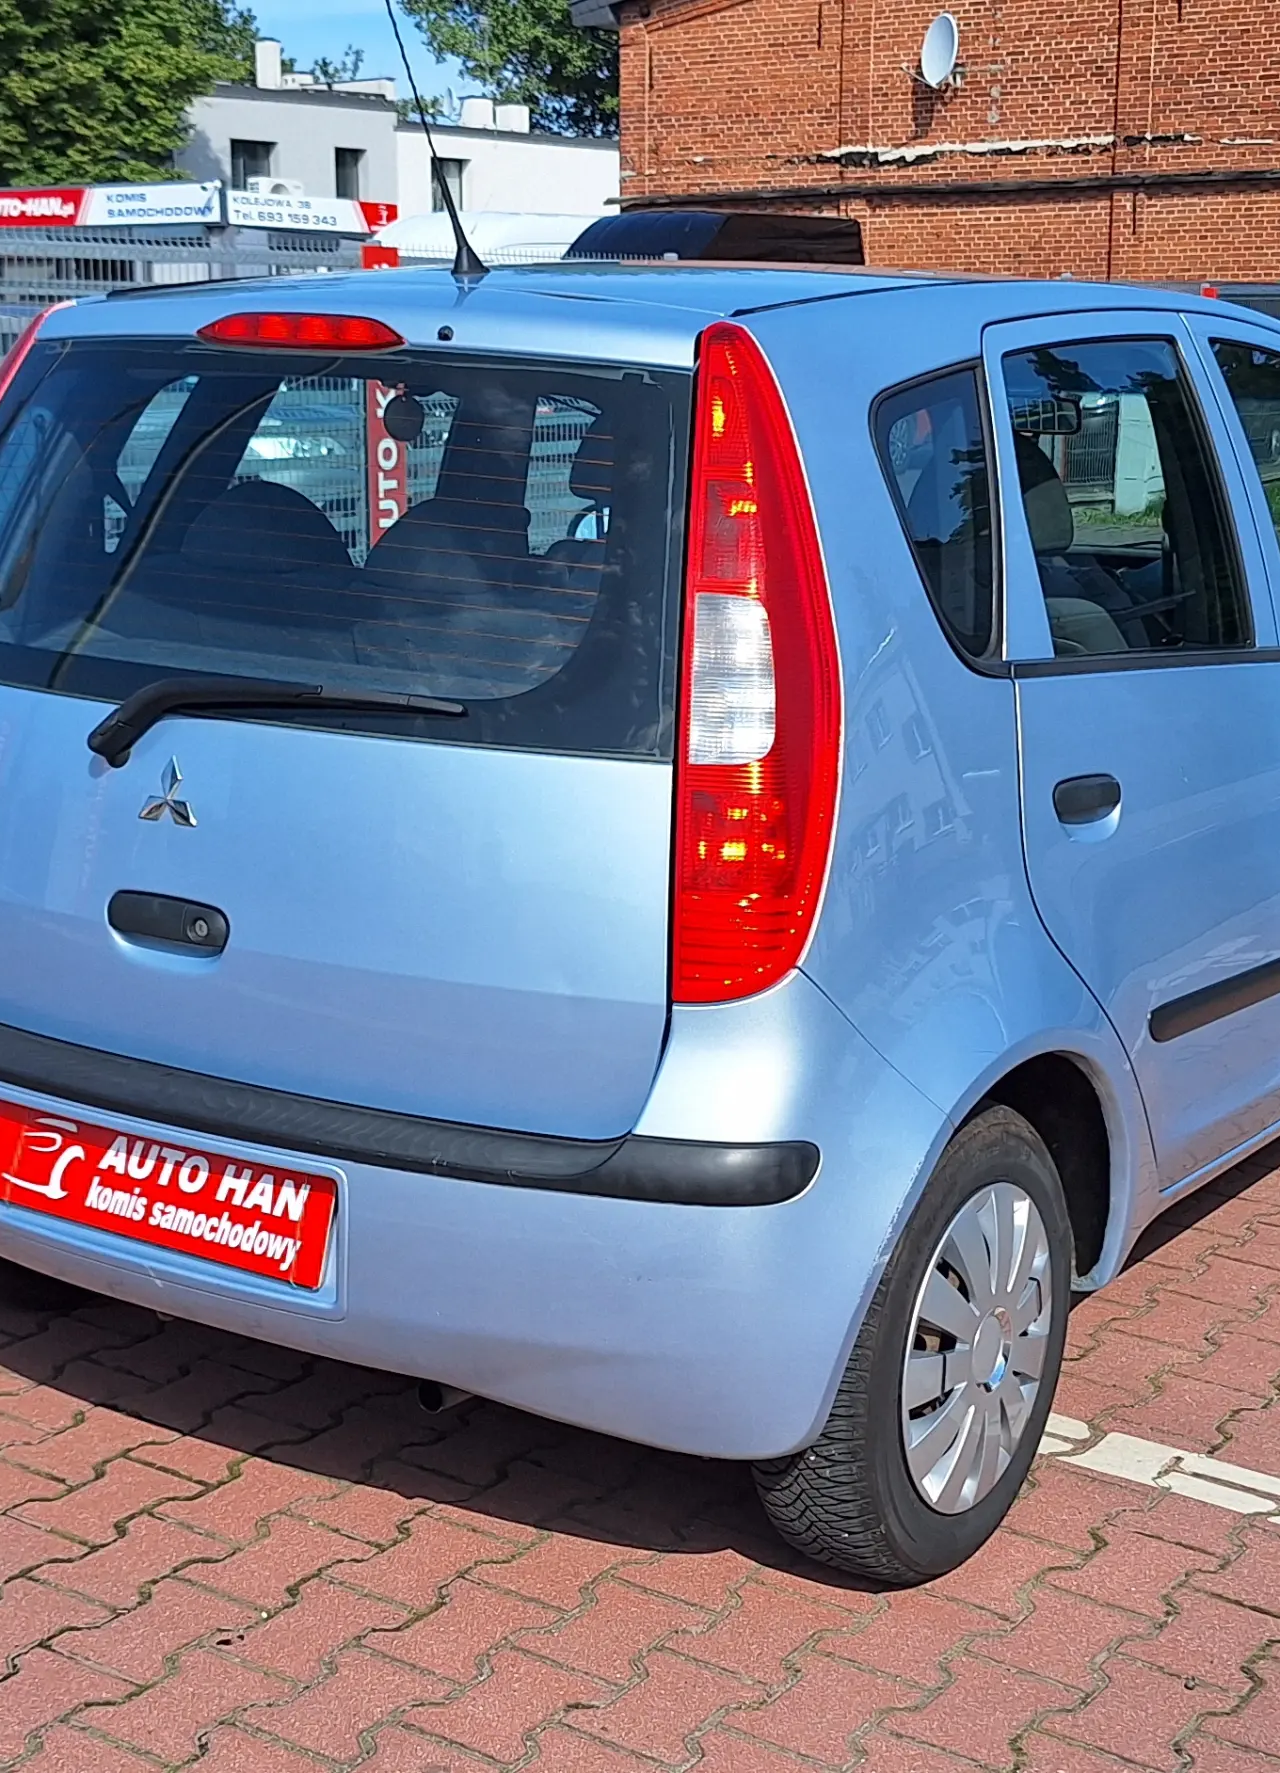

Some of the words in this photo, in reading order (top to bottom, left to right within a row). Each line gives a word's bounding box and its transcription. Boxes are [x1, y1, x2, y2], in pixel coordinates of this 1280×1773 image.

[105, 193, 147, 204] KOMIS
[233, 196, 293, 208] KOLEJOWA
[107, 205, 214, 218] SAMOCHODOWY
[258, 211, 283, 222] 693
[287, 213, 310, 224] 159
[312, 215, 337, 226] 343
[377, 438, 399, 529] UTO
[97, 1134, 210, 1194] AUTO
[215, 1163, 311, 1222] HAN
[84, 1175, 148, 1222] komis
[148, 1199, 302, 1271] samochodowy
